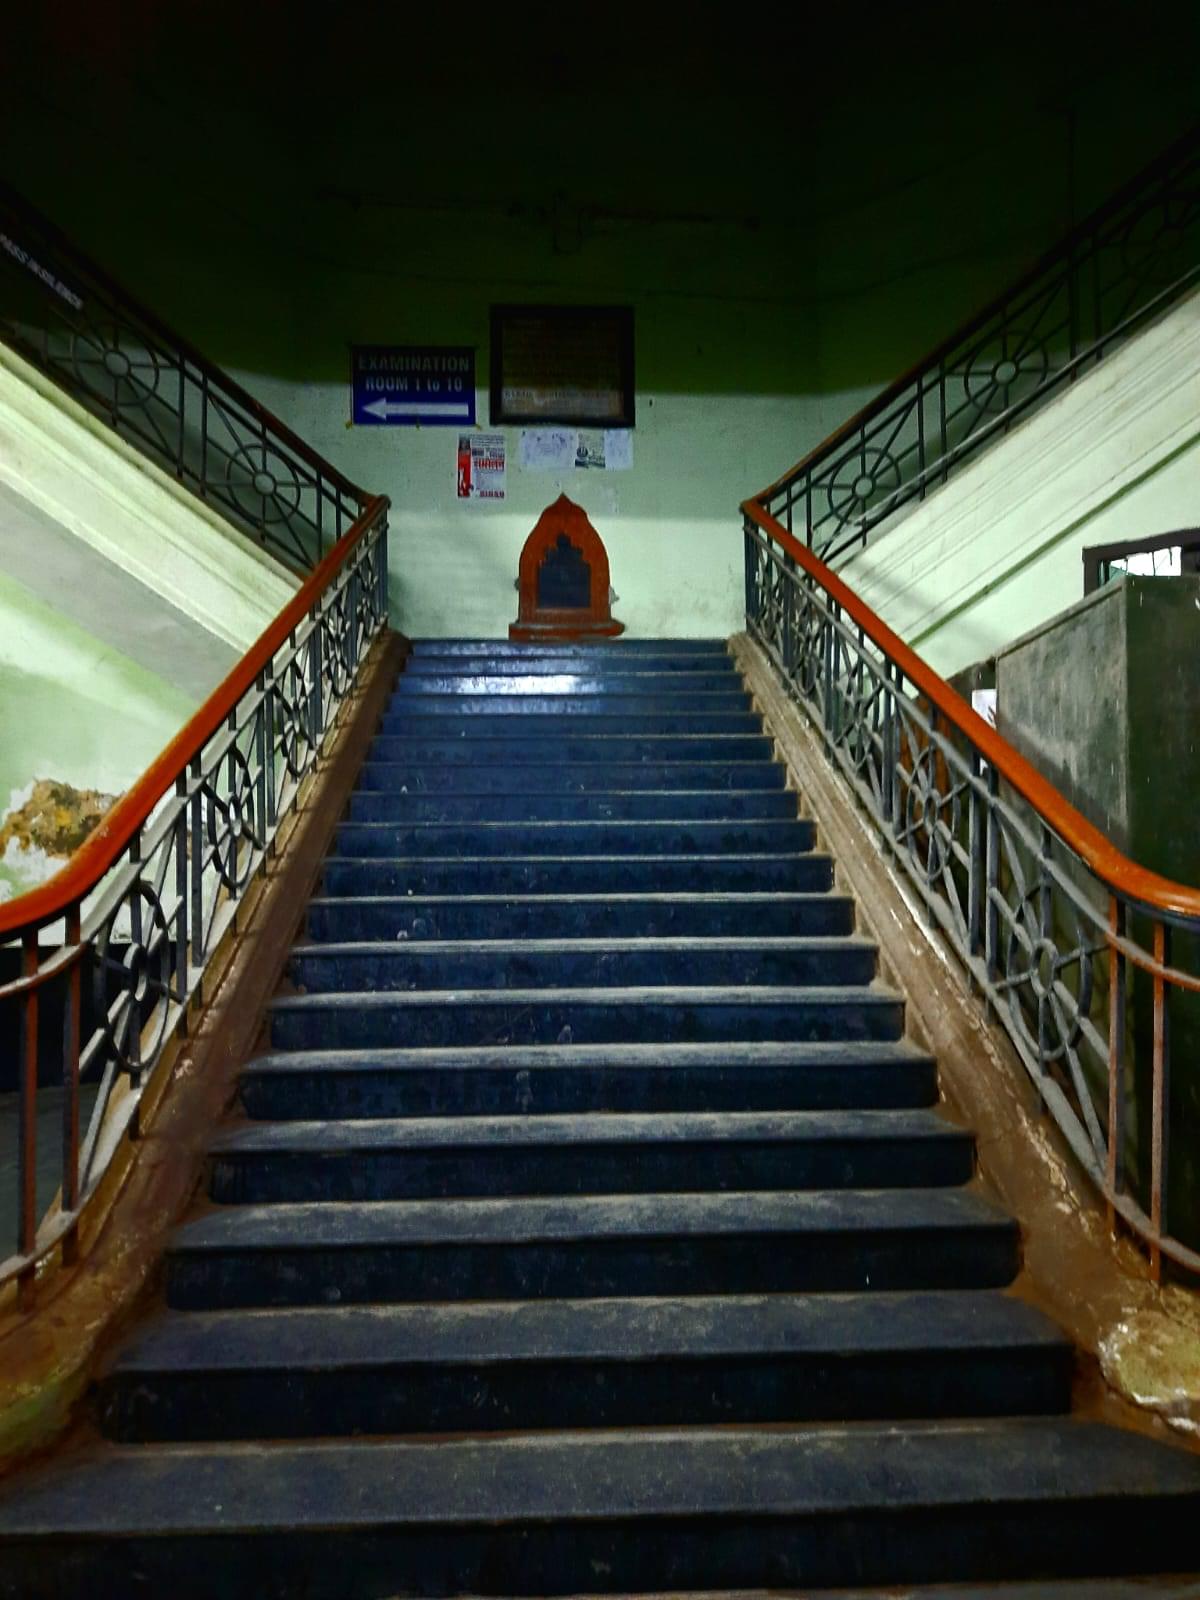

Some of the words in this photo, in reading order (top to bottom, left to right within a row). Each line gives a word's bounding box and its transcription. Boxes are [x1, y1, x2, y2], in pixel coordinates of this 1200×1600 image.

[358, 353, 470, 372] EXAMINATION
[365, 376, 409, 392] ROOM
[415, 376, 421, 392] 1
[447, 376, 463, 392] 10
